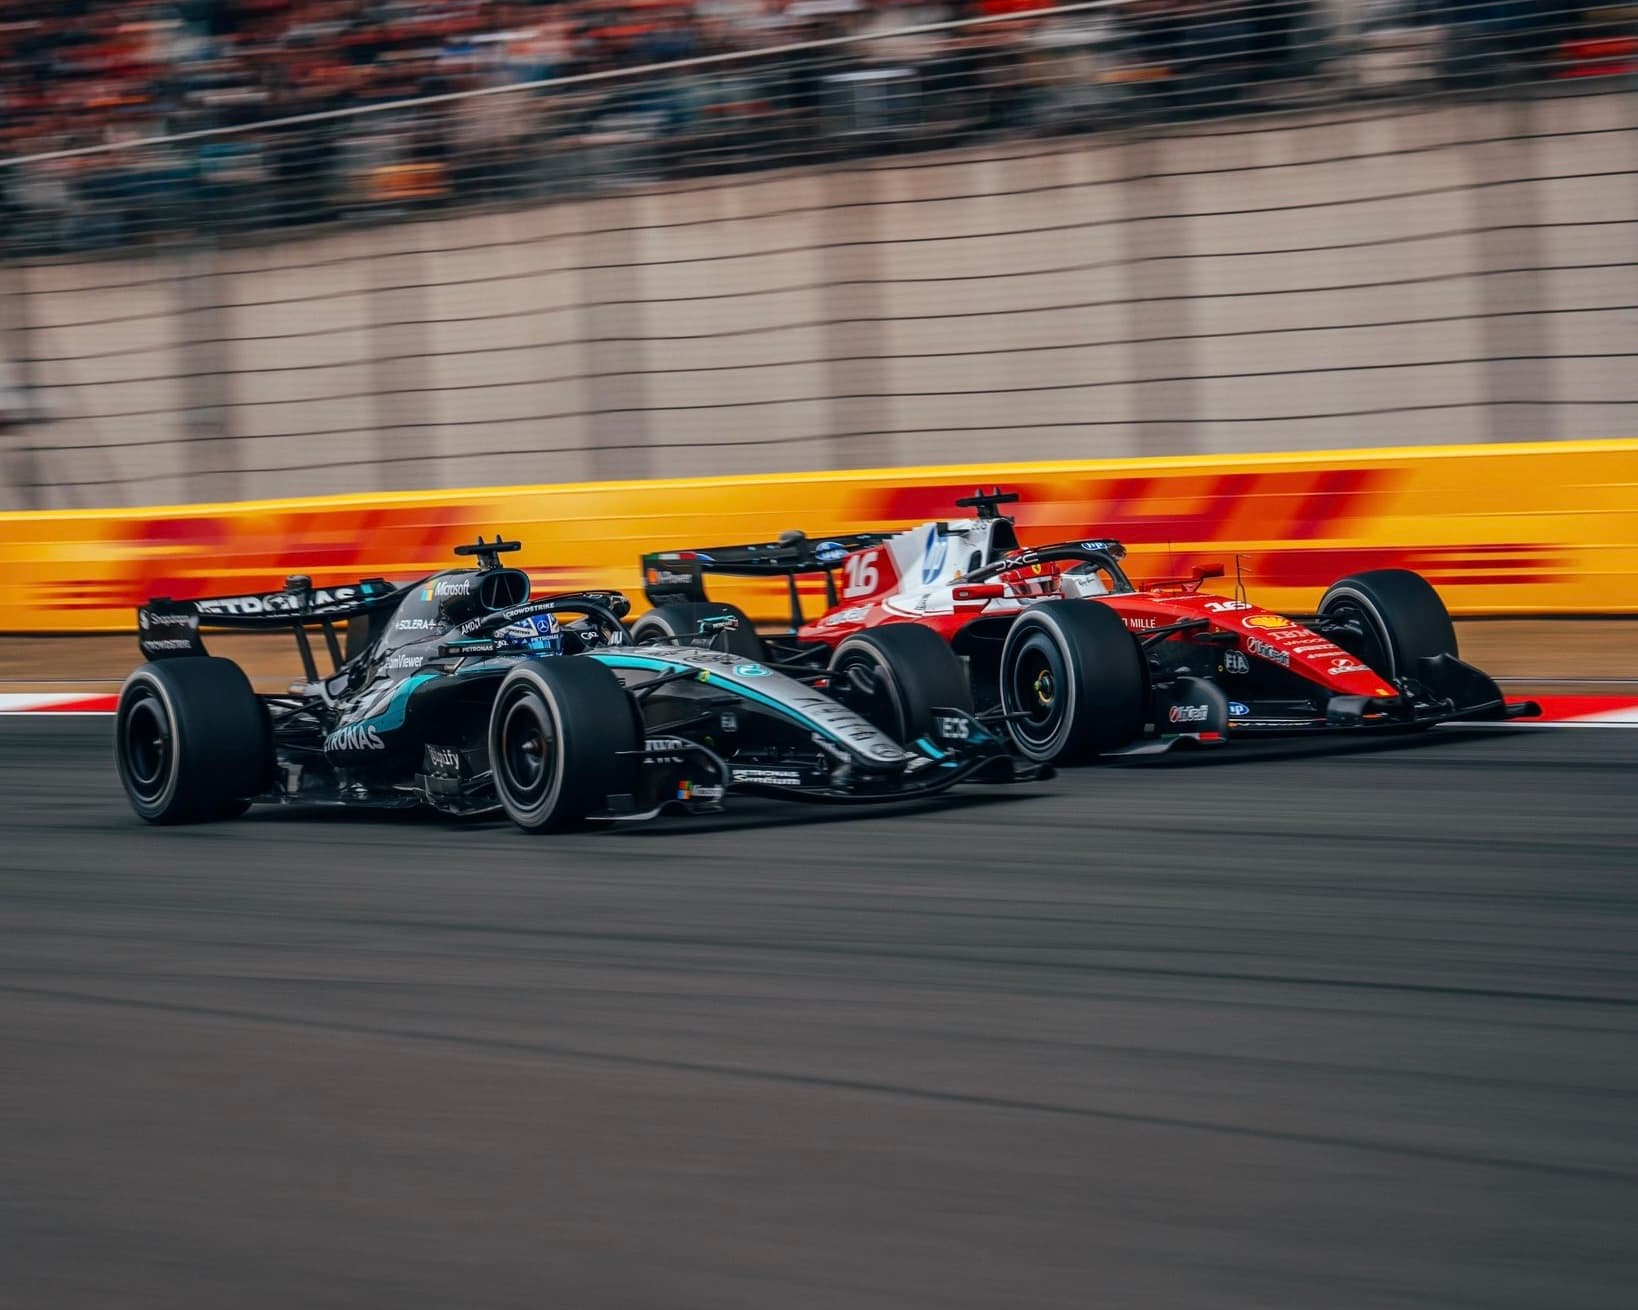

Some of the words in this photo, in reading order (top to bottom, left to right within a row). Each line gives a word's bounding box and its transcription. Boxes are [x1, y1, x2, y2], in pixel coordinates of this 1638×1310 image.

[844, 552, 879, 598] 16
[435, 579, 470, 596] Microsoft
[506, 602, 555, 619] CROWDSTRIKE
[1204, 600, 1252, 612] 16
[399, 619, 429, 630] SOLERA
[1225, 653, 1246, 671] FIA
